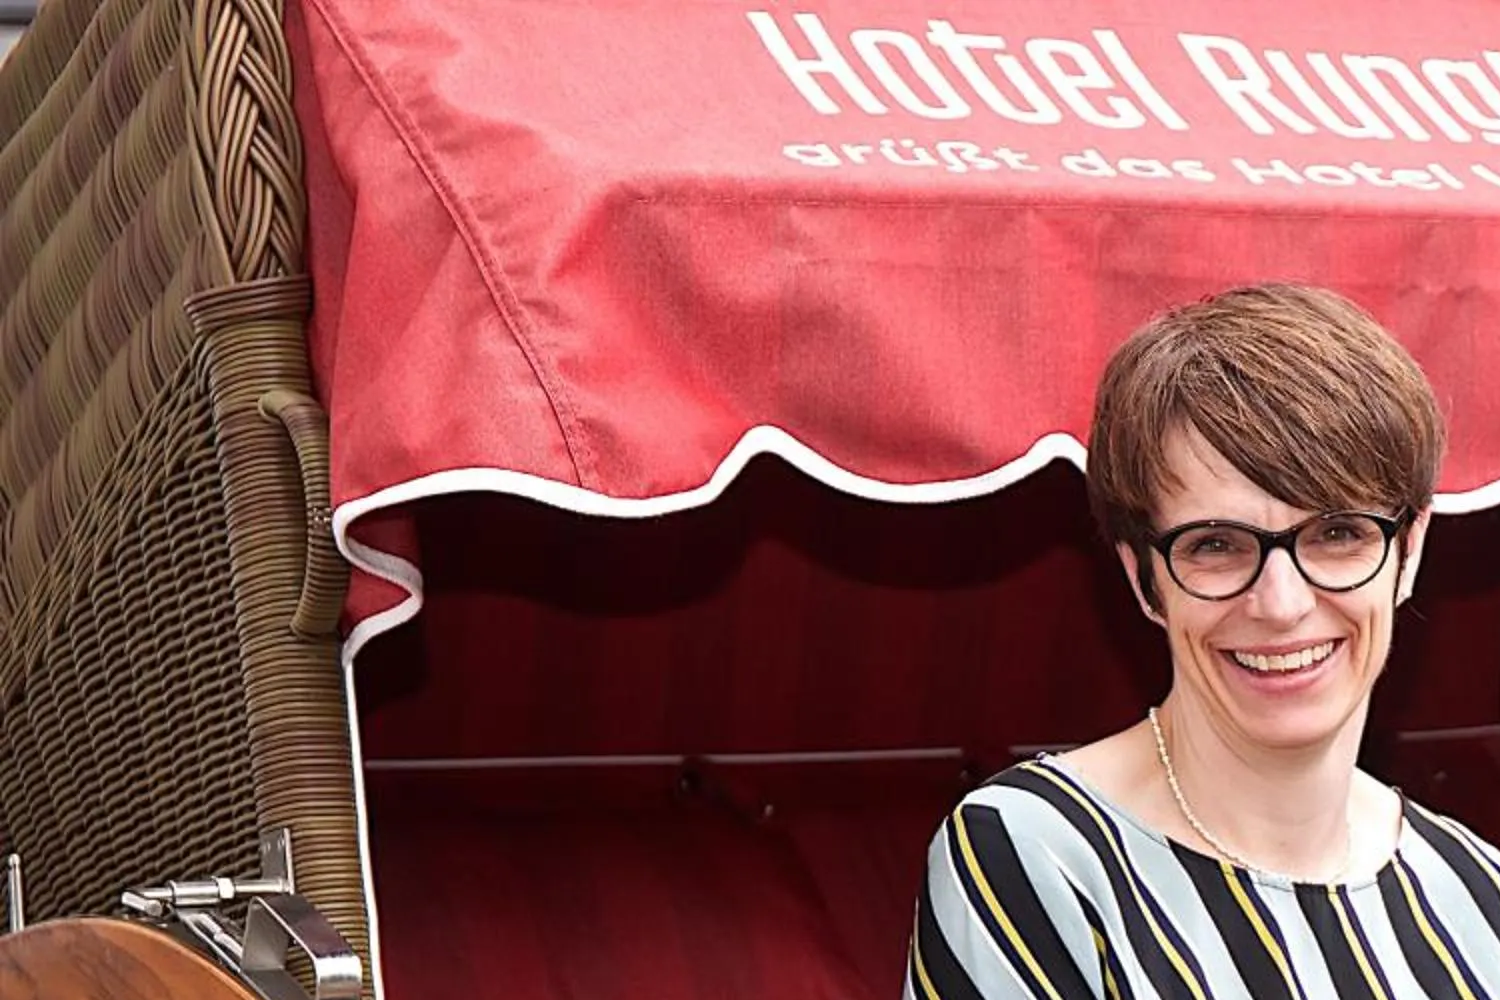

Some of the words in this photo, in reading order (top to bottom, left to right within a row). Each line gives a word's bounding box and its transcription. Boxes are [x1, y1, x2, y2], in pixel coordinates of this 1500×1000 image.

[746, 10, 1191, 132] Hotel
[781, 138, 1041, 174] grüßt
[1060, 149, 1217, 184] das
[1230, 157, 1466, 192] Hotel
